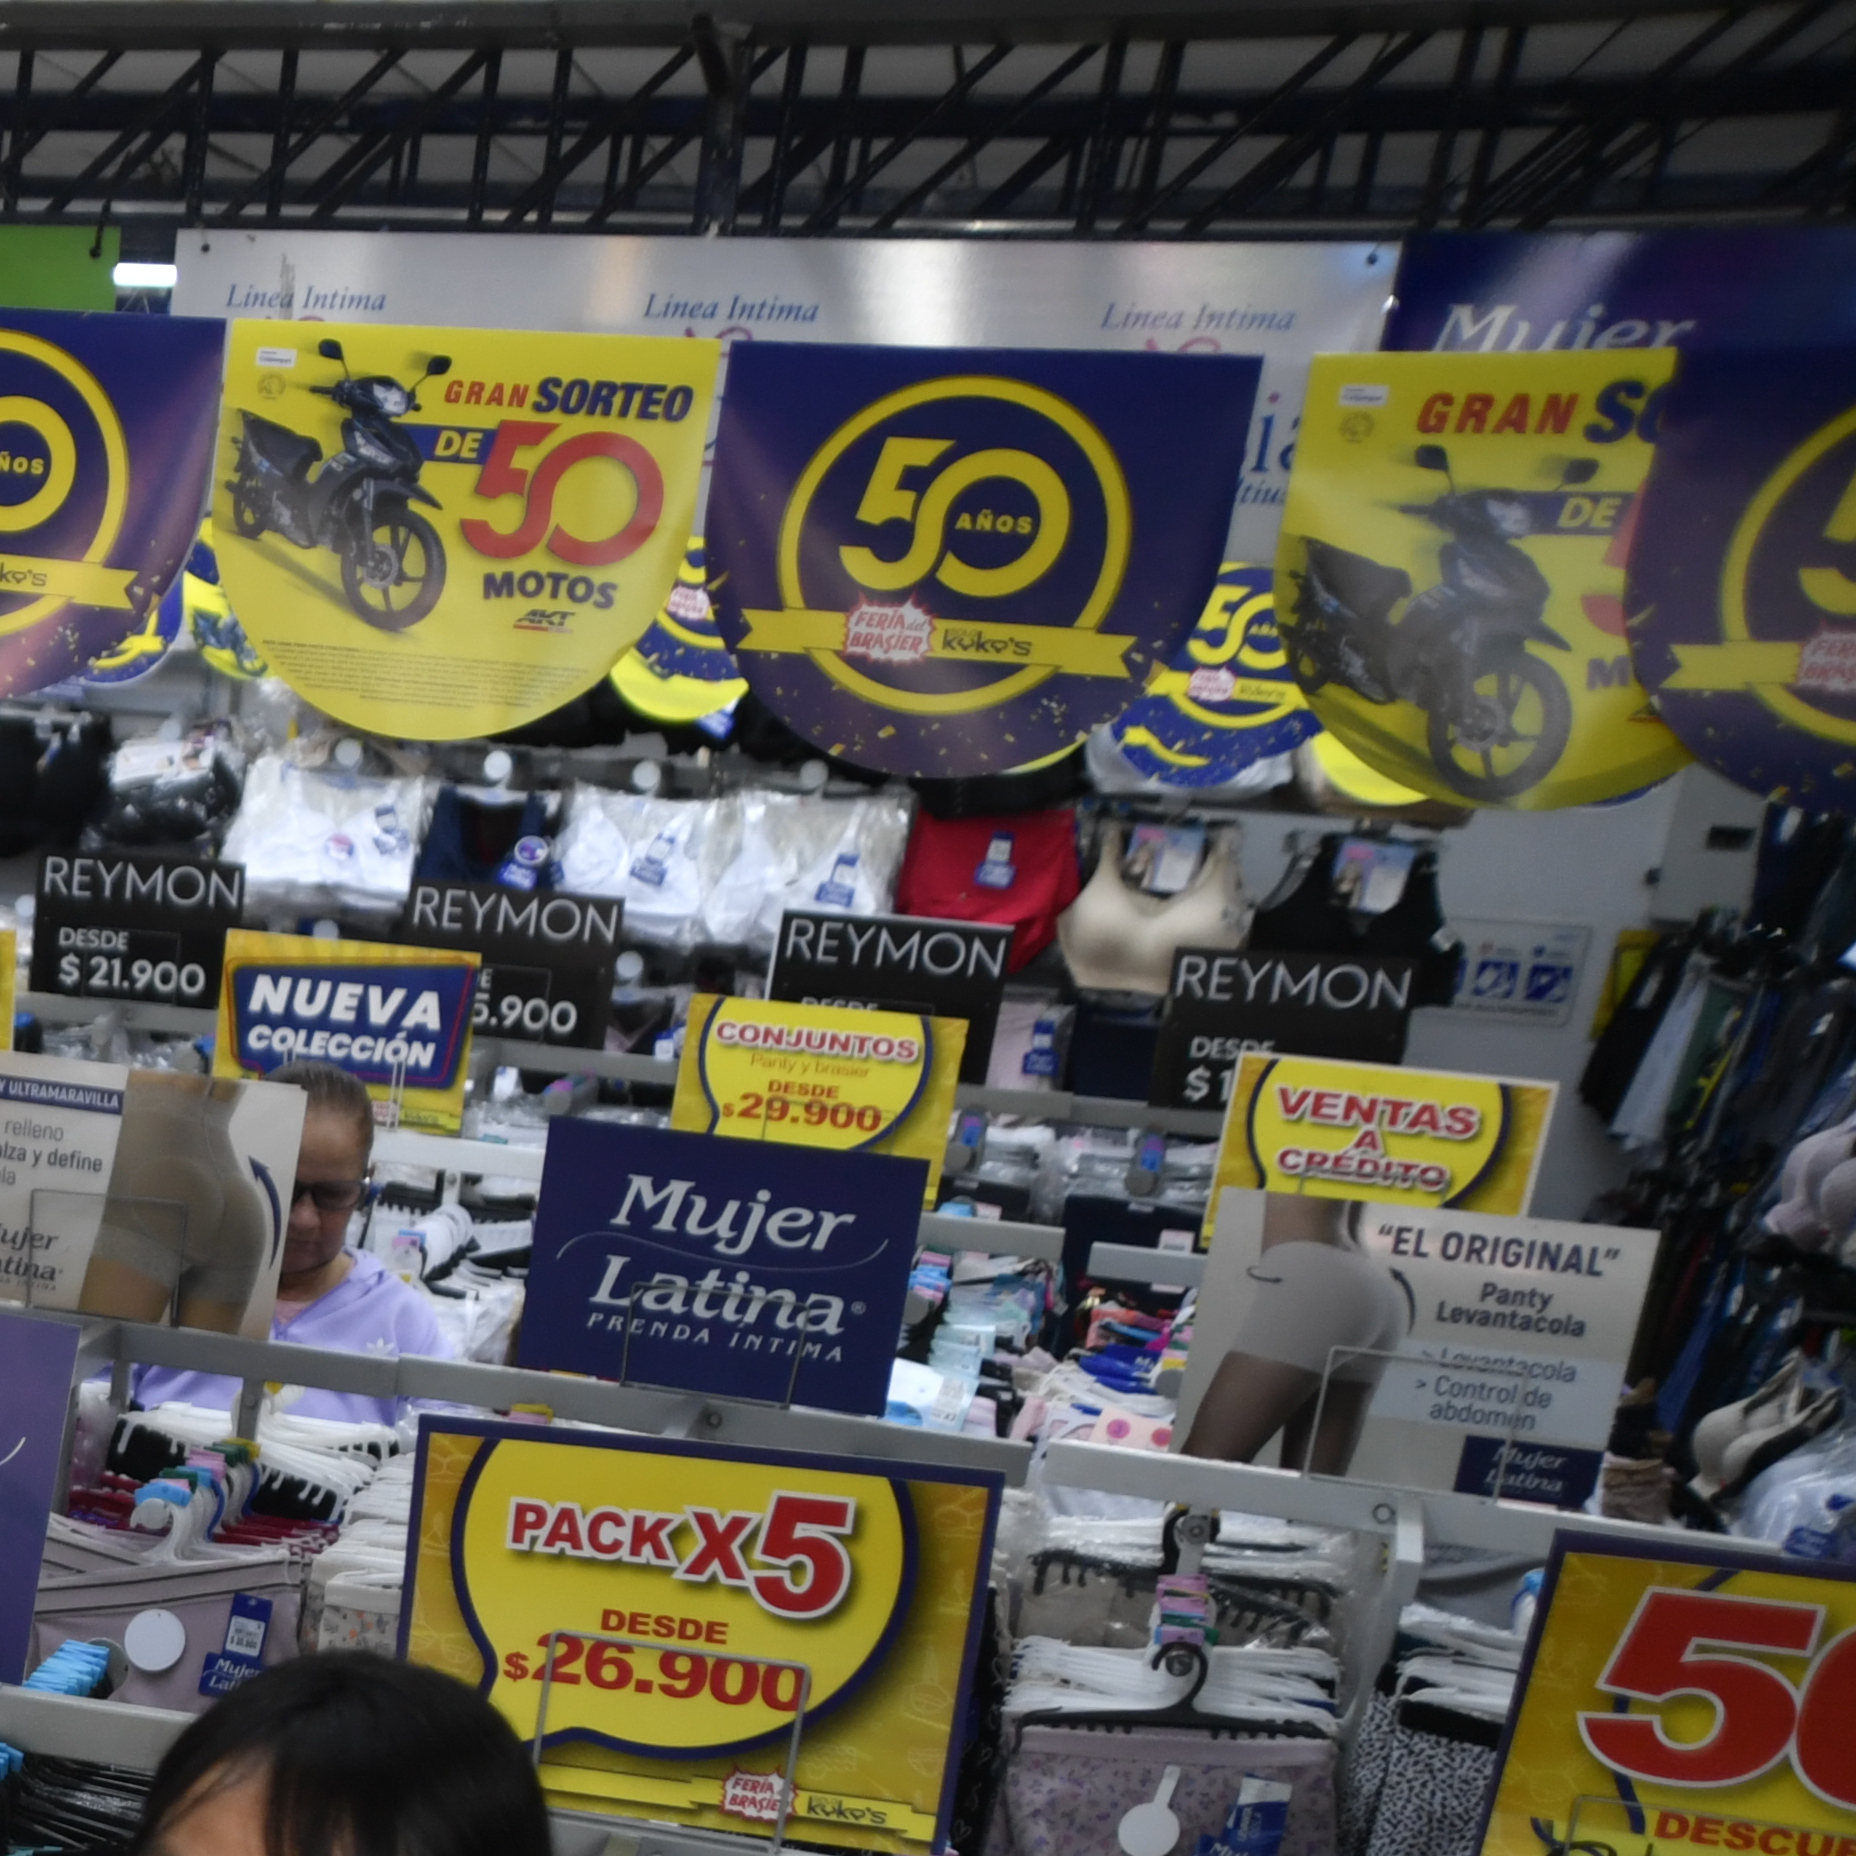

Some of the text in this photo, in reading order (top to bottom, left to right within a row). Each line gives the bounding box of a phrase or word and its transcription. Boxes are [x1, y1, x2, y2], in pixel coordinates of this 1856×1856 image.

[226, 283, 387, 313] Linea Intima
[643, 291, 820, 323] Linea Intima
[1100, 302, 1296, 332] Linea Intima
[444, 375, 695, 424] GRAN SORTEO
[1415, 391, 1581, 436] GRAN
[434, 418, 665, 568] DE 50
[839, 435, 1071, 599] 50
[954, 509, 1034, 536] AÑOS
[1556, 496, 1618, 530] DE
[482, 570, 619, 610] MOTOS
[848, 630, 923, 654] BRASIER
[43, 855, 242, 909] REYMON
[412, 885, 621, 945] REYMON
[58, 926, 129, 952] DESDE
[786, 917, 1007, 979] REYMON
[1174, 954, 1413, 1011] REYMON
[248, 973, 442, 1032] NUEVA
[247, 1025, 437, 1068] COLECCIÓN
[715, 1021, 920, 1062] CONJUNTOS
[750, 1052, 871, 1080] Panty brasier
[8, 1078, 120, 1109] ULTRAMARAVILLA
[767, 1079, 839, 1100] DESDE
[4, 1117, 65, 1142] relleno
[1276, 1086, 1482, 1139] VENTAS
[1352, 1127, 1381, 1152] A
[32, 1149, 43, 1168] y
[47, 1147, 104, 1175] define
[1276, 1146, 1452, 1192] CRÉDITO
[609, 1173, 857, 1256] Mujer
[589, 1253, 847, 1336] Latina
[1479, 1281, 1555, 1315] Panty
[586, 1311, 844, 1363] PRENDA ÍNTIMA
[1435, 1300, 1588, 1340] Levantacola
[1438, 1346, 1578, 1385] Levantacola
[1434, 1374, 1553, 1410] Control de
[1428, 1401, 1538, 1432] abdomen
[1491, 1443, 1569, 1473] Mujer
[1483, 1467, 1567, 1494] Latina
[509, 1500, 678, 1564] PACK
[599, 1608, 729, 1645] DESDE
